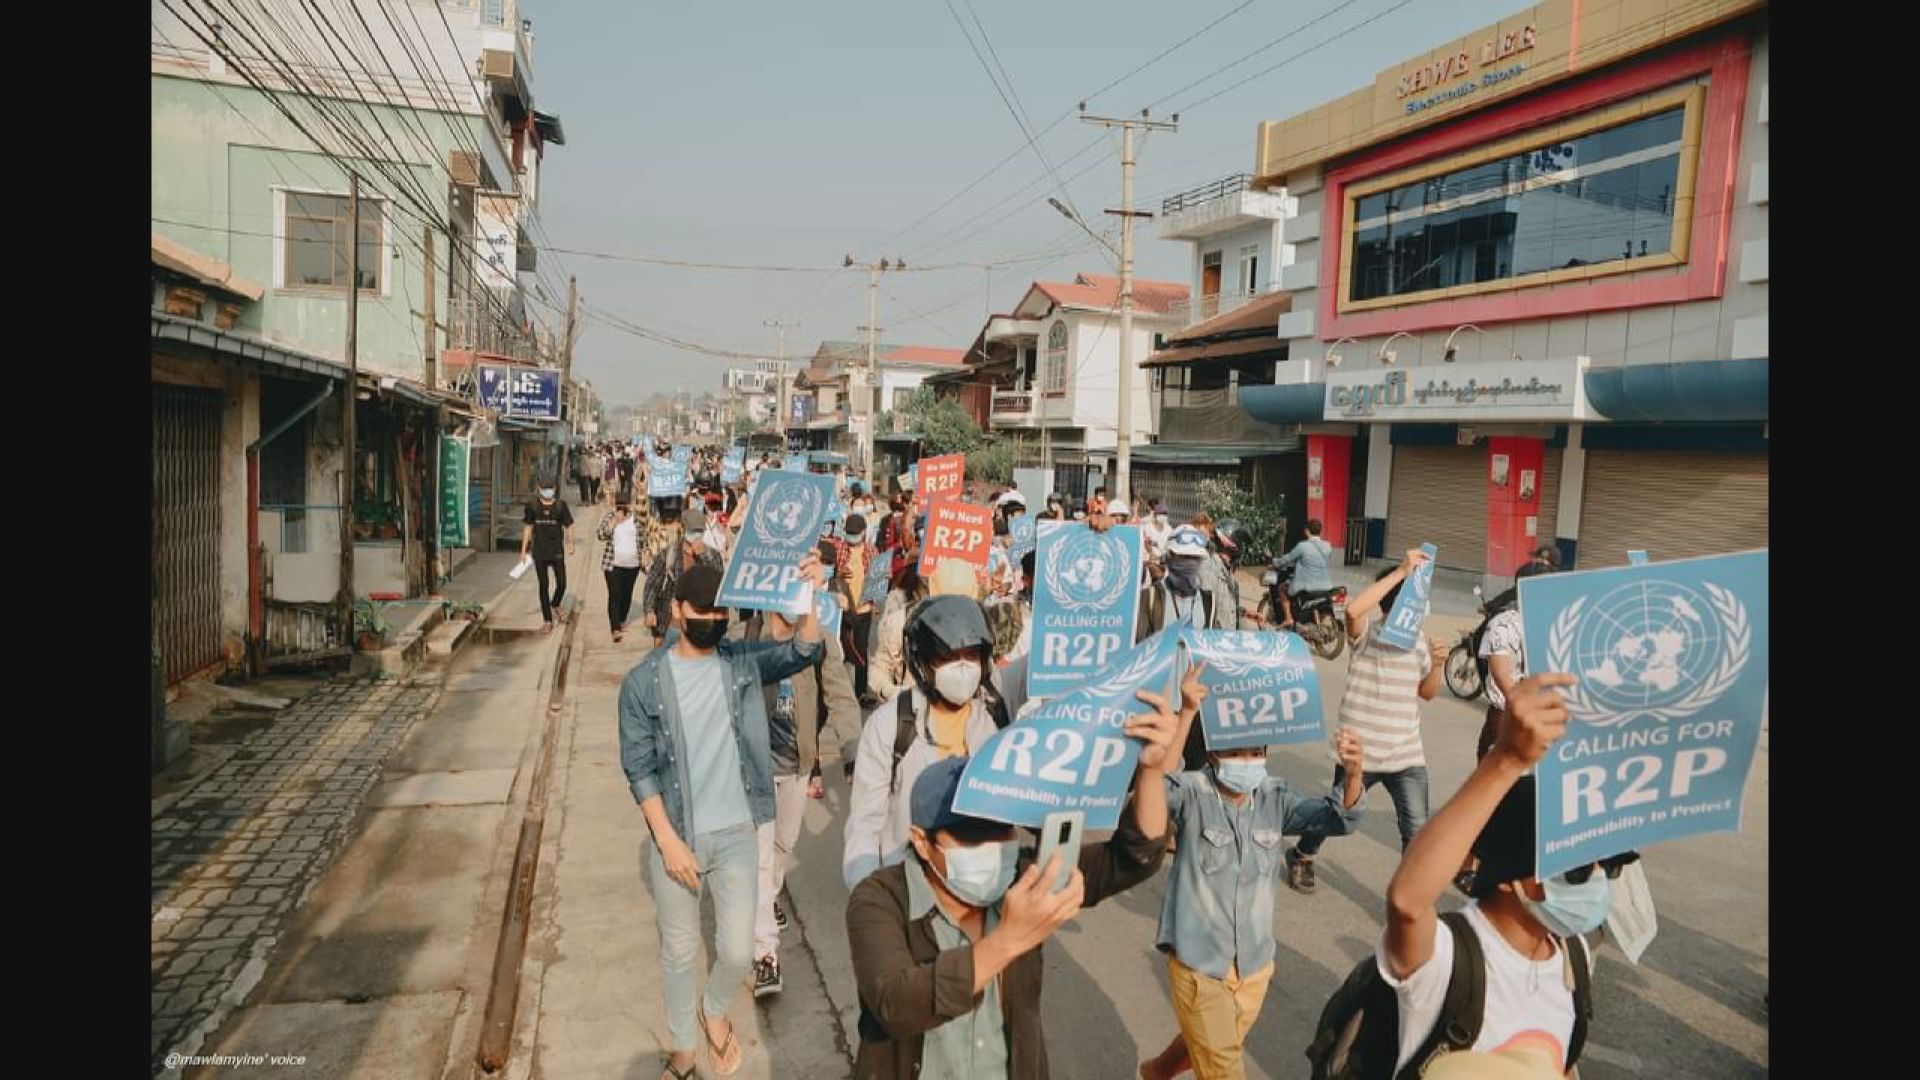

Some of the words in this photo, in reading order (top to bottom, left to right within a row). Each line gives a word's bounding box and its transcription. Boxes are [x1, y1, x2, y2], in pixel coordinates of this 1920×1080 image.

[1397, 51, 1468, 98] SHWE
[1480, 25, 1536, 67] LEE
[925, 473, 959, 493] R2P
[939, 508, 955, 520] We
[958, 511, 984, 525] Need
[743, 546, 785, 561] CALLING
[933, 525, 983, 552] R2P
[735, 562, 801, 593] R2P
[1044, 614, 1098, 627] CALLING
[1101, 614, 1123, 627] FOR
[1043, 632, 1120, 667] R2P
[1211, 674, 1274, 696] CALLING
[1275, 668, 1305, 686] FOR
[1217, 688, 1310, 727] R2P
[990, 726, 1127, 786] R2P
[1559, 727, 1670, 763] CALLING
[1677, 720, 1735, 743] FOR
[967, 776, 1060, 807] Responsibility
[1561, 747, 1728, 826] R2P
[1544, 815, 1645, 855] Responsibility
[1650, 810, 1667, 823] to
[1671, 799, 1732, 818] Protect
